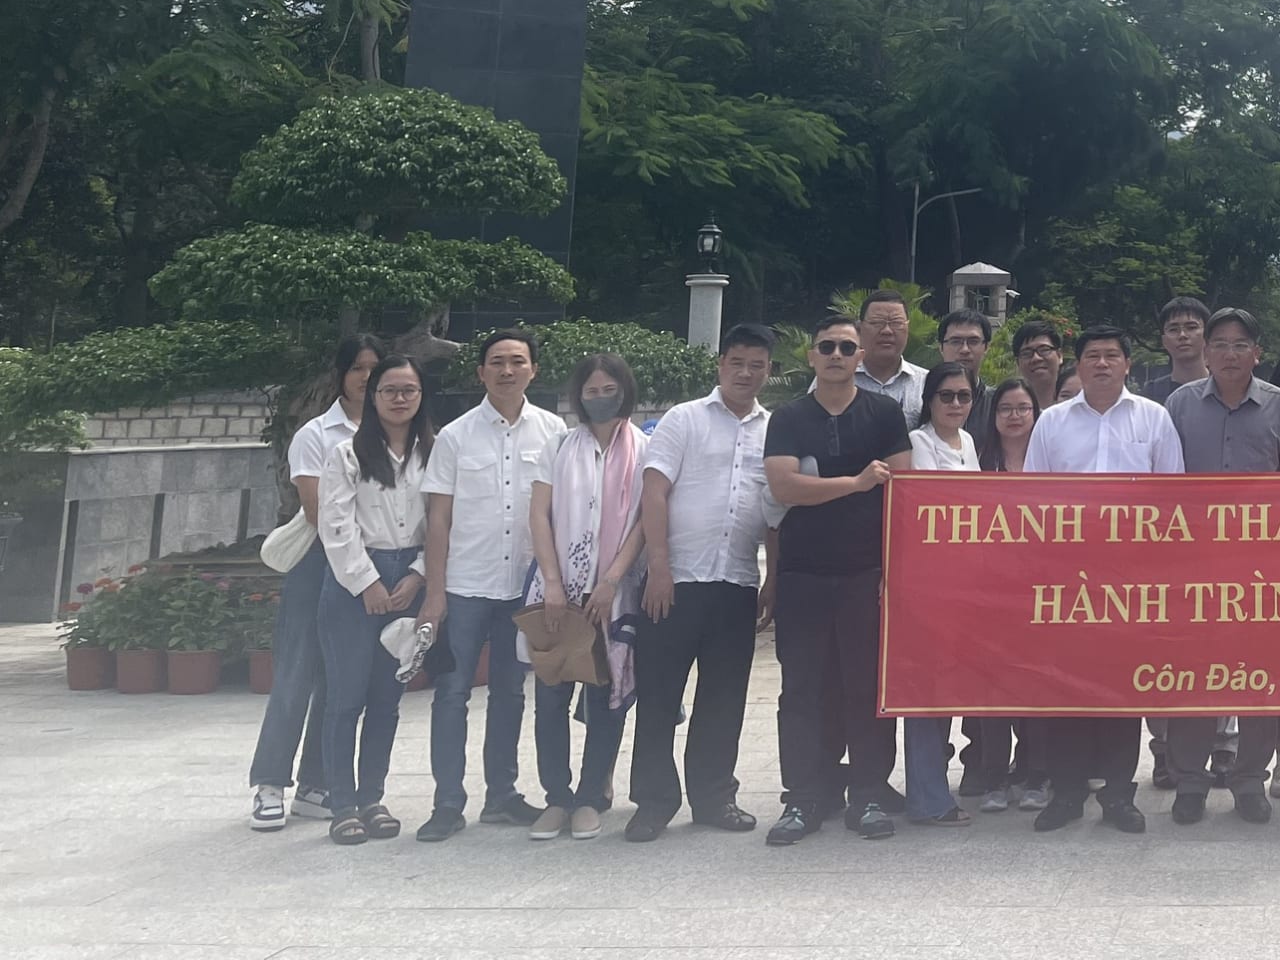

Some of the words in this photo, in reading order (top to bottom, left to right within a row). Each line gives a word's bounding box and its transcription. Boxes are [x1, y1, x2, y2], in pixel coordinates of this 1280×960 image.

[917, 504, 1086, 544] THANH
[1100, 504, 1195, 542] TRA
[1030, 571, 1171, 624] HÀNH
[1132, 664, 1196, 692] Côn
[1205, 662, 1276, 695] Đảo,
